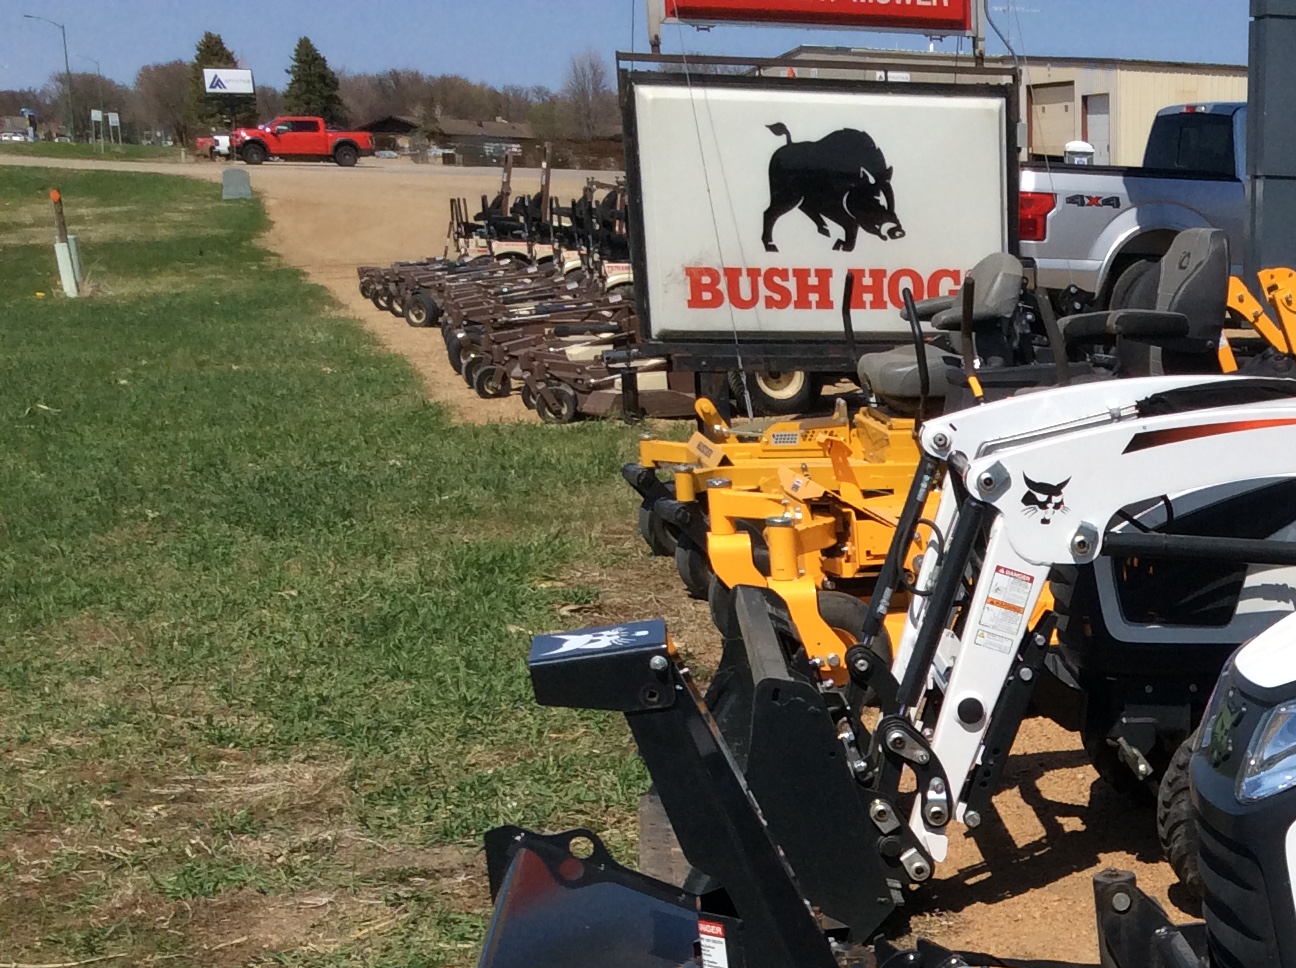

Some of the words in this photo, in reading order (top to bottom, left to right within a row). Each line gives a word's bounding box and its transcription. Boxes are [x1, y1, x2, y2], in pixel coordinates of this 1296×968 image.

[684, 266, 834, 310] BUSH
[848, 267, 961, 310] HOG
[698, 923, 724, 935] NGER
